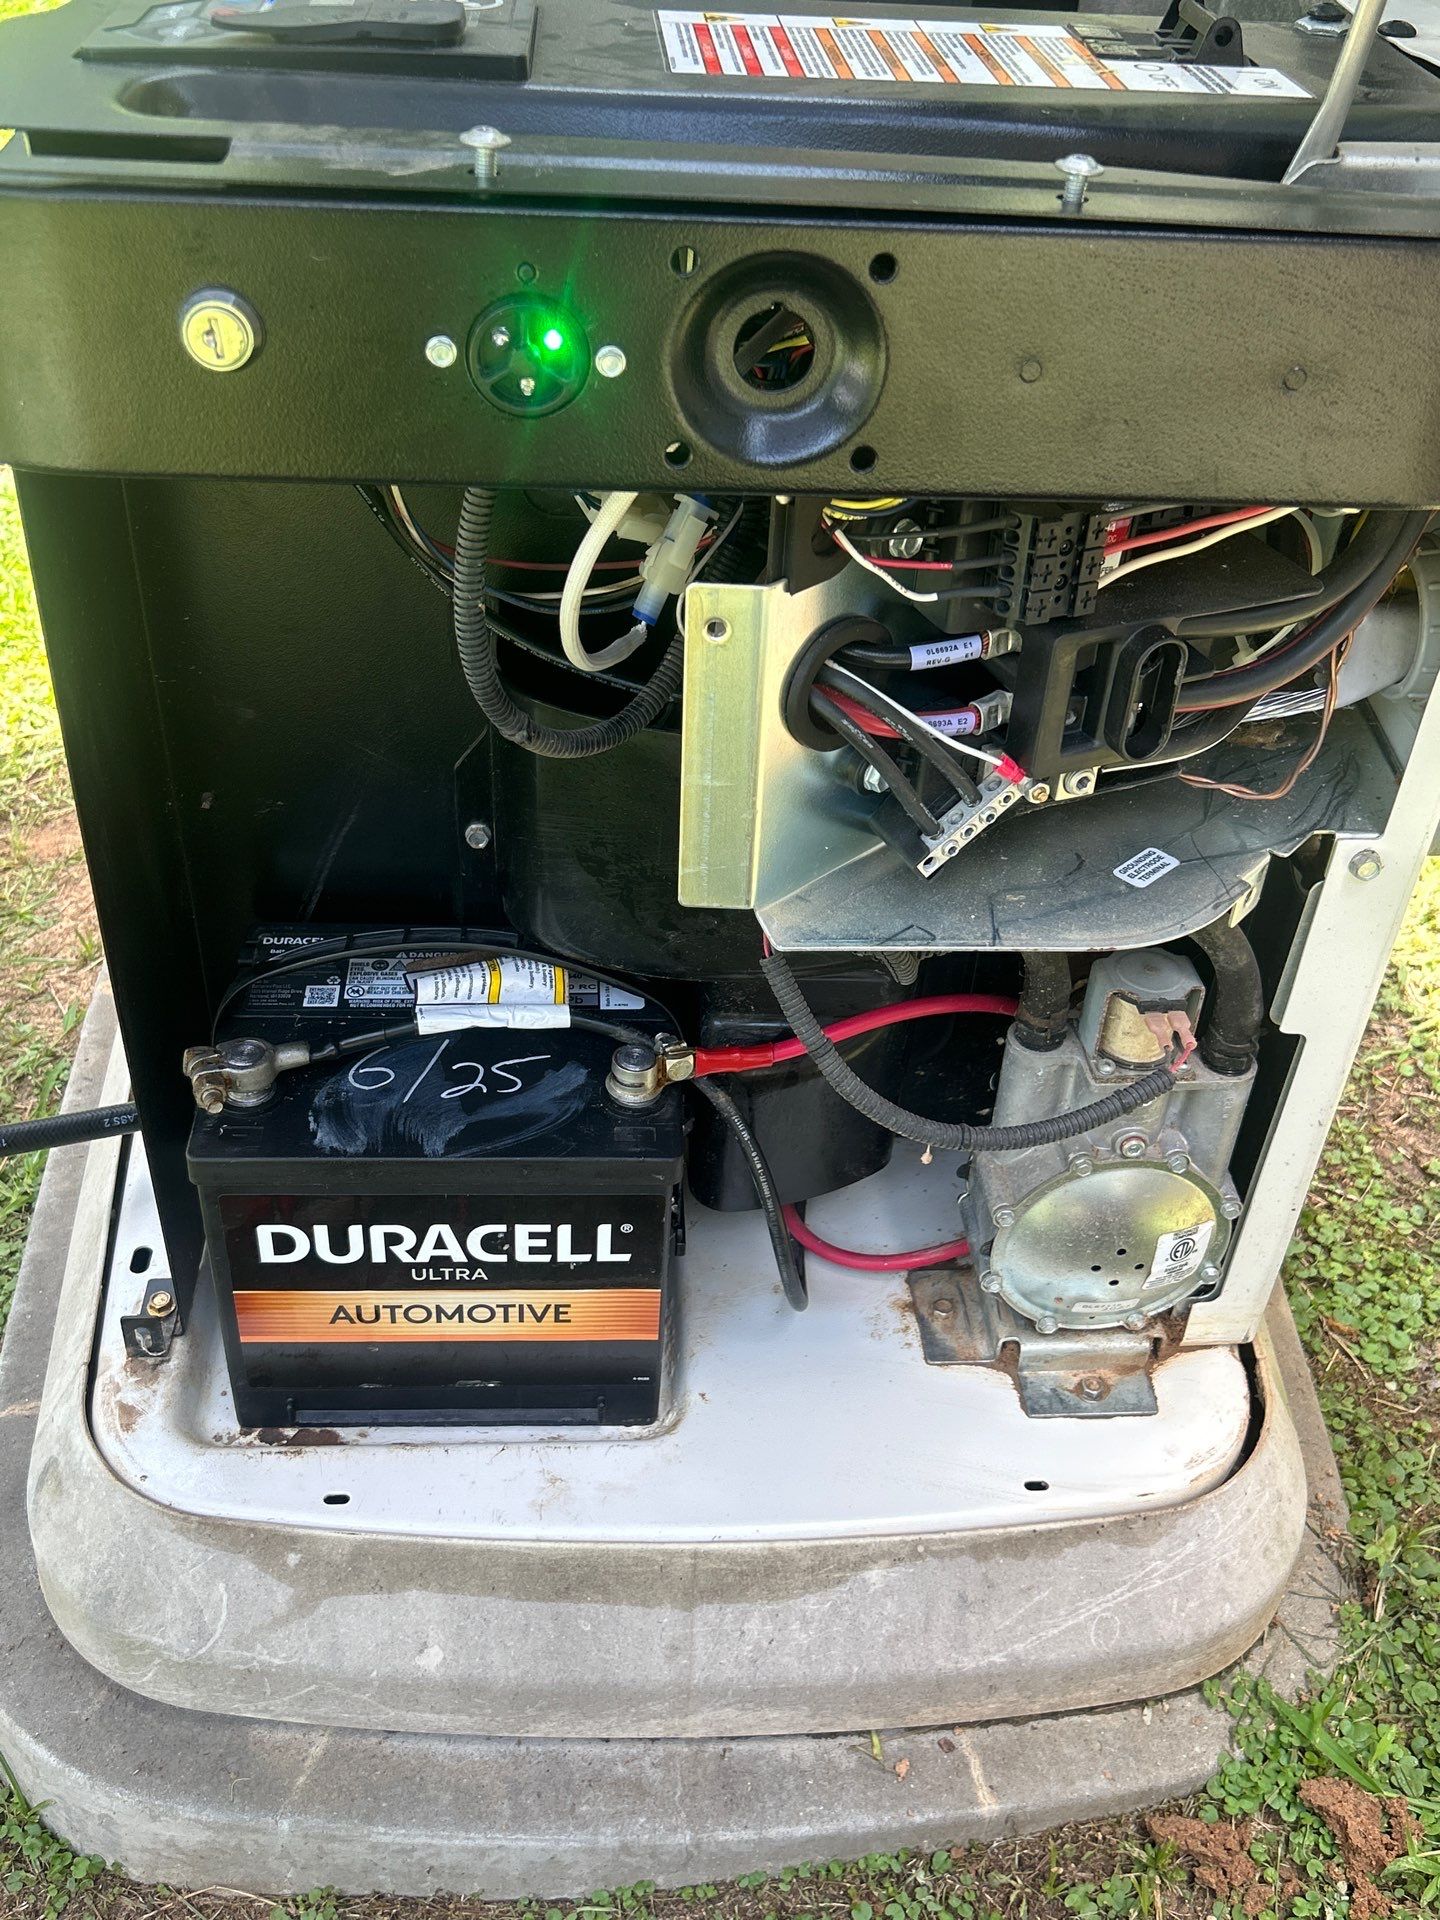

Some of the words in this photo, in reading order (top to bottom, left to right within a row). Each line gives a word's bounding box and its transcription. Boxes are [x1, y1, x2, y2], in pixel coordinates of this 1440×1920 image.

[963, 641, 973, 650] E1
[957, 717, 968, 726] E2
[1119, 850, 1157, 875] GROUNDING
[1127, 854, 1165, 879] ELECTRODE
[1138, 862, 1171, 882] TERMINAL
[349, 1039, 551, 1103] 6/25
[255, 1223, 633, 1265] DURACELL
[411, 1267, 489, 1282] ULTRA
[329, 1303, 572, 1325] AUTOMOTIVE
